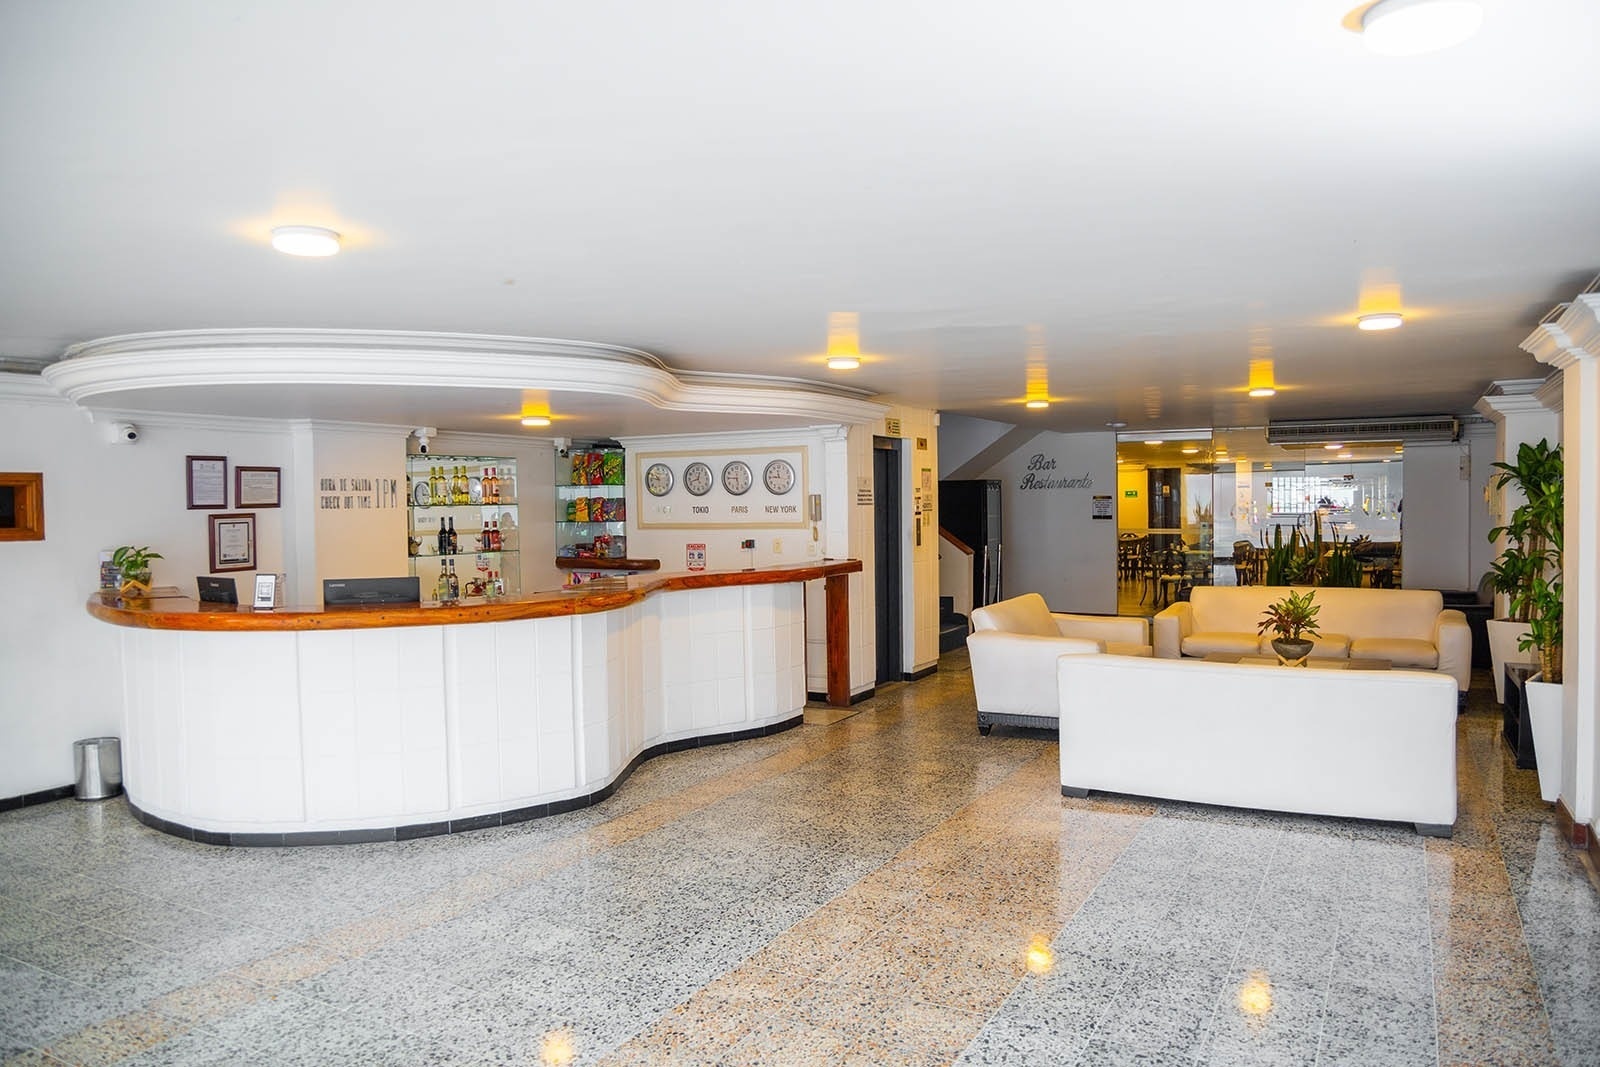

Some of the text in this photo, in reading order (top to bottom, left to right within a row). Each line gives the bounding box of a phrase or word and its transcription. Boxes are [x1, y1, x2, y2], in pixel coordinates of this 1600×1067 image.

[1027, 453, 1057, 471] Bar
[320, 478, 337, 492] HORA
[351, 478, 372, 492] SALIDA
[320, 495, 371, 509] CHECK OUT TIME
[692, 506, 709, 514] TOKIO
[730, 505, 749, 514] PARIS
[764, 505, 797, 514] NEW YORK
